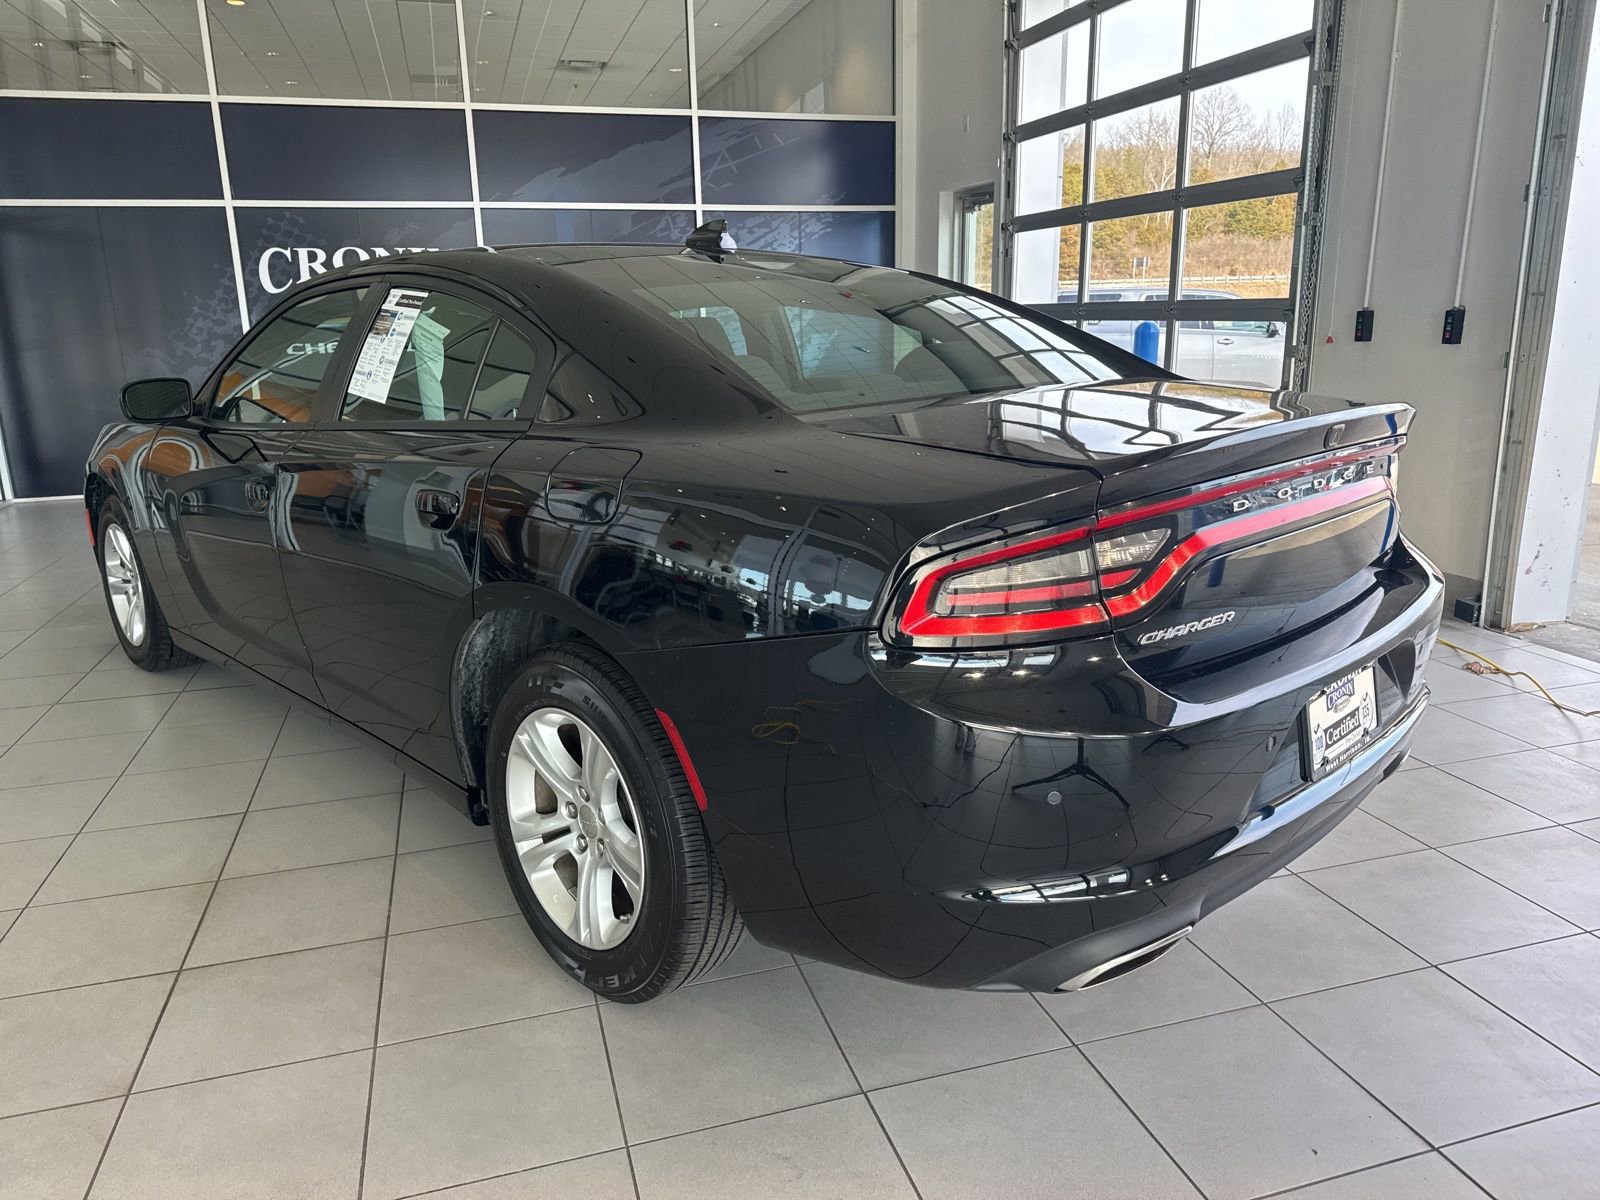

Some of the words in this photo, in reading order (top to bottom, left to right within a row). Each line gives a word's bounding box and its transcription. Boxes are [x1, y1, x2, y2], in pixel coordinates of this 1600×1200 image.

[1232, 464, 1376, 513] DODGE
[1138, 610, 1236, 646] CHARGER
[1327, 681, 1354, 709] CRONIN
[1326, 711, 1360, 745] Certified
